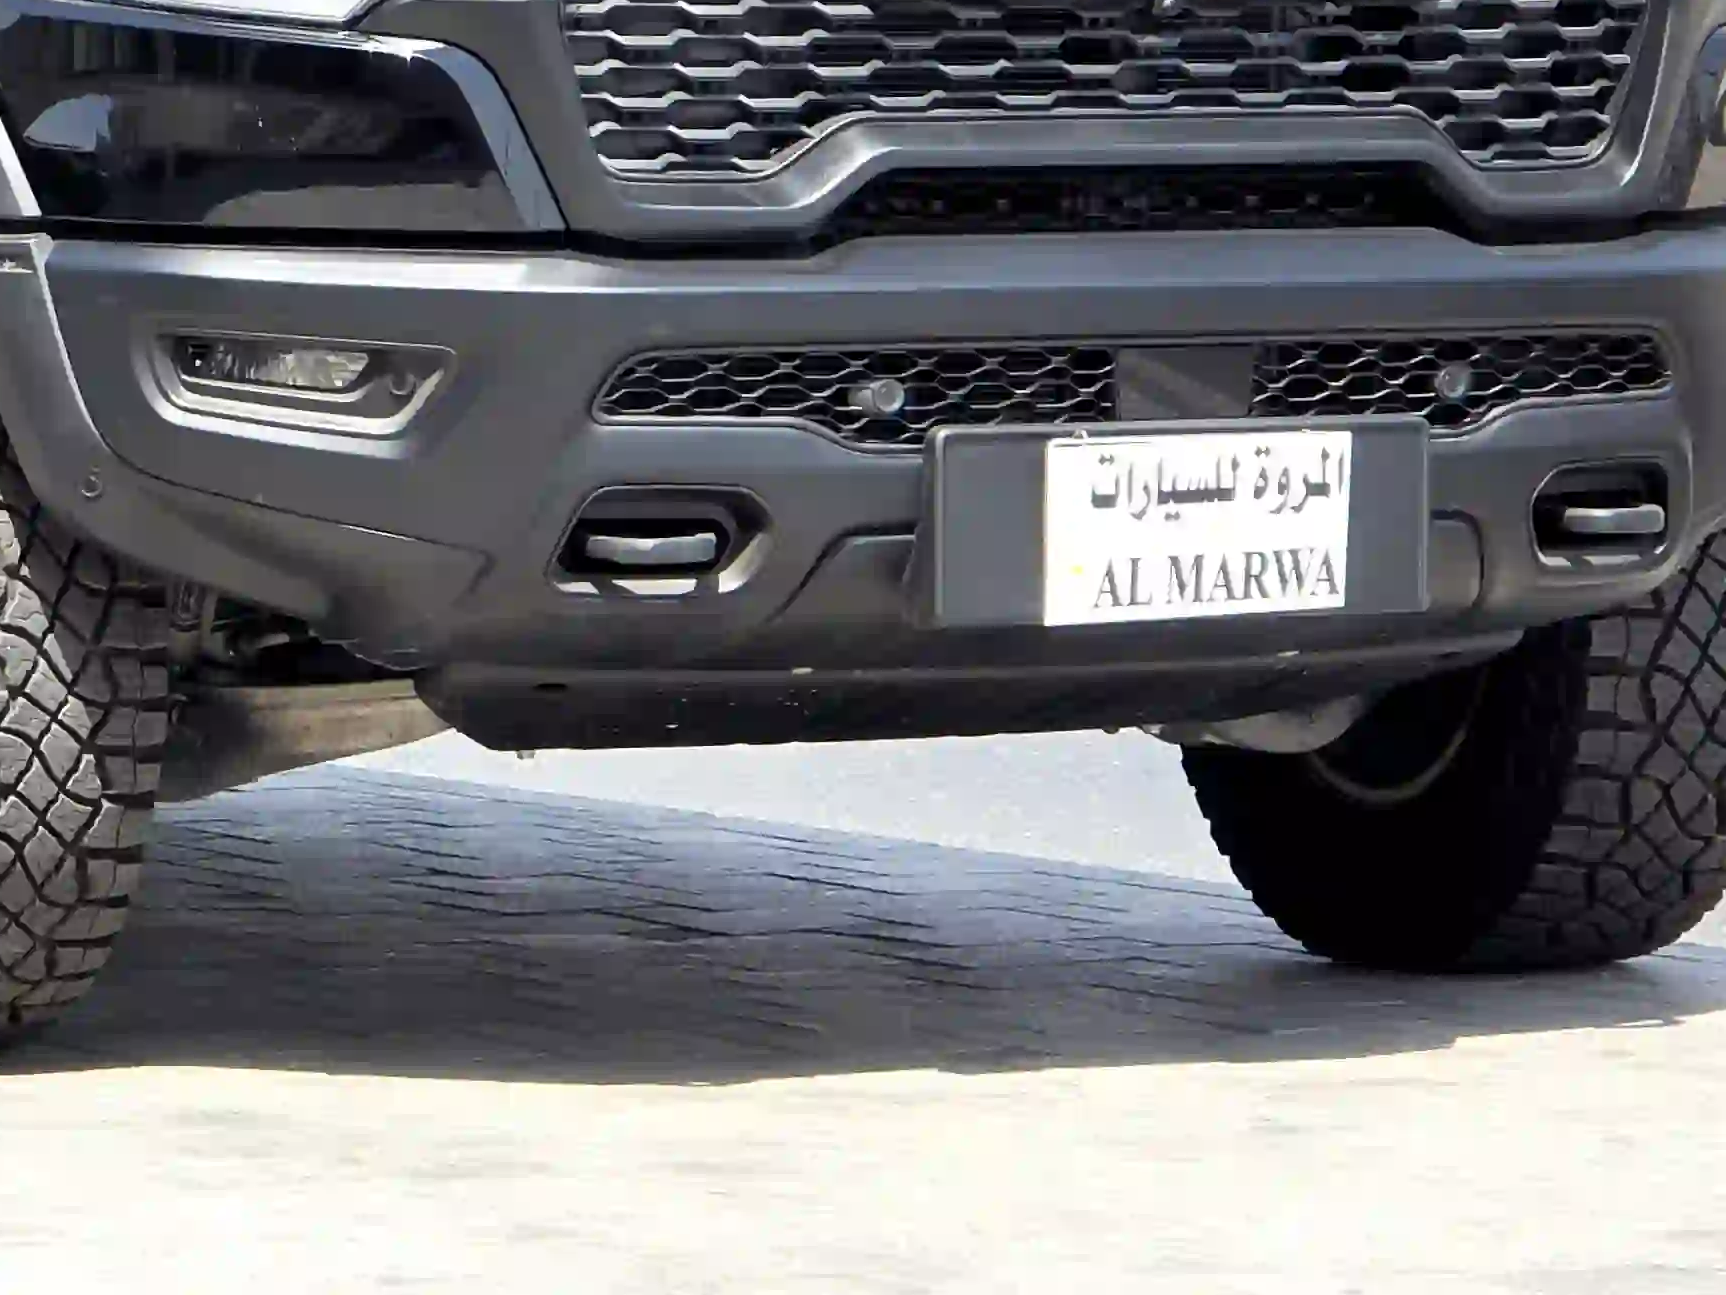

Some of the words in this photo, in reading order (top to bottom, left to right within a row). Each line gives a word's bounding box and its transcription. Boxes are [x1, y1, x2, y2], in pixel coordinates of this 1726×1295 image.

[1091, 453, 1240, 521] للسيارات
[1254, 446, 1344, 513] المروة
[1093, 557, 1152, 607] AL
[1166, 547, 1340, 604] MARWA
